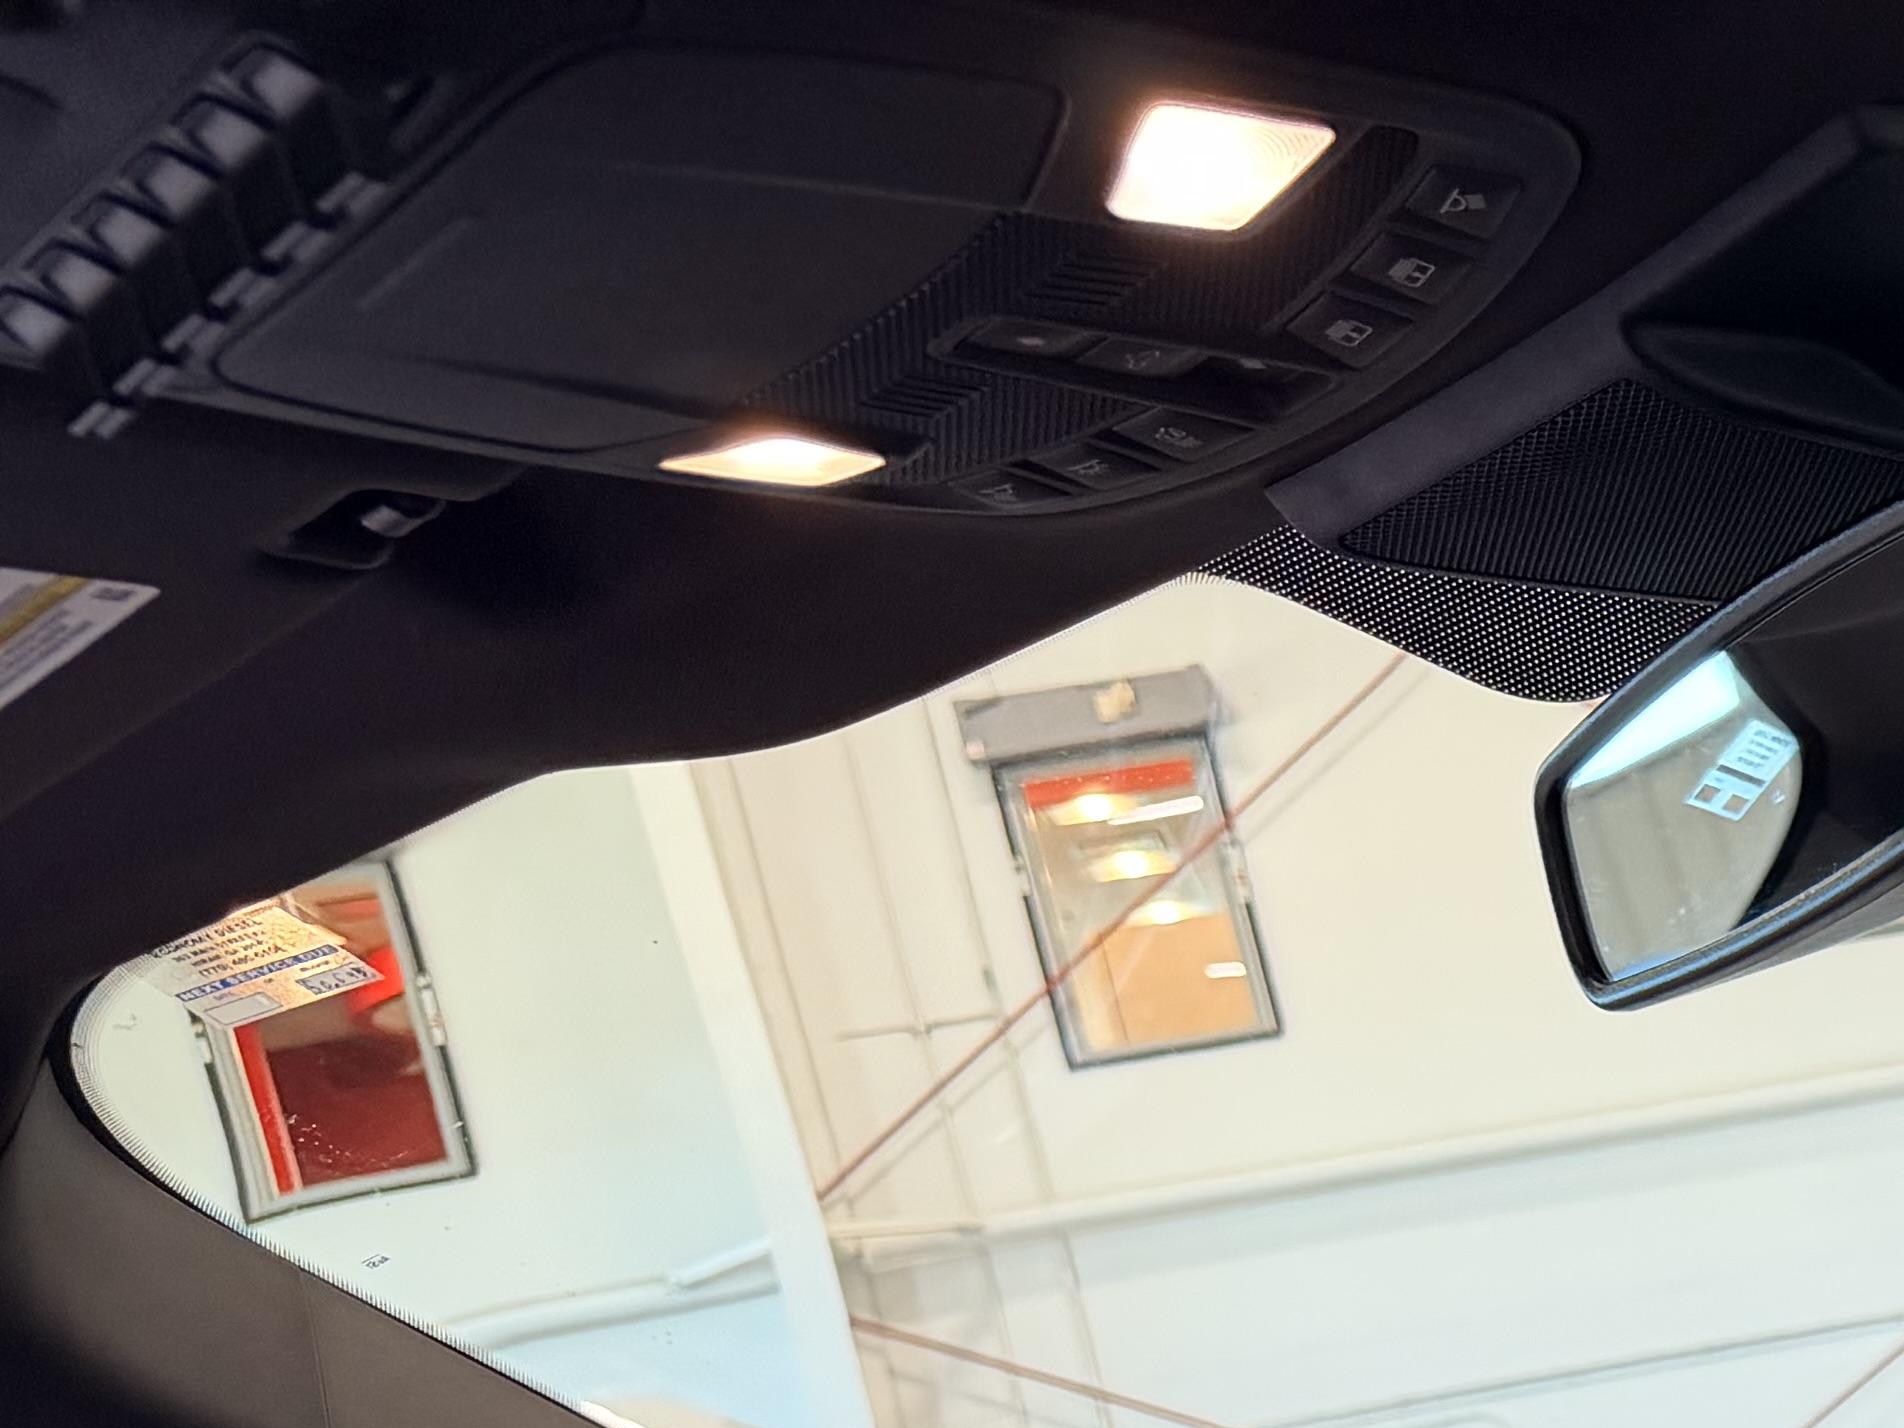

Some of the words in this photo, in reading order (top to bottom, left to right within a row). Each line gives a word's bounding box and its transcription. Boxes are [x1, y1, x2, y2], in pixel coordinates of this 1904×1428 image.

[178, 978, 223, 1000] NEXT
[226, 957, 293, 986] SERVICE
[298, 945, 336, 964] DUE
